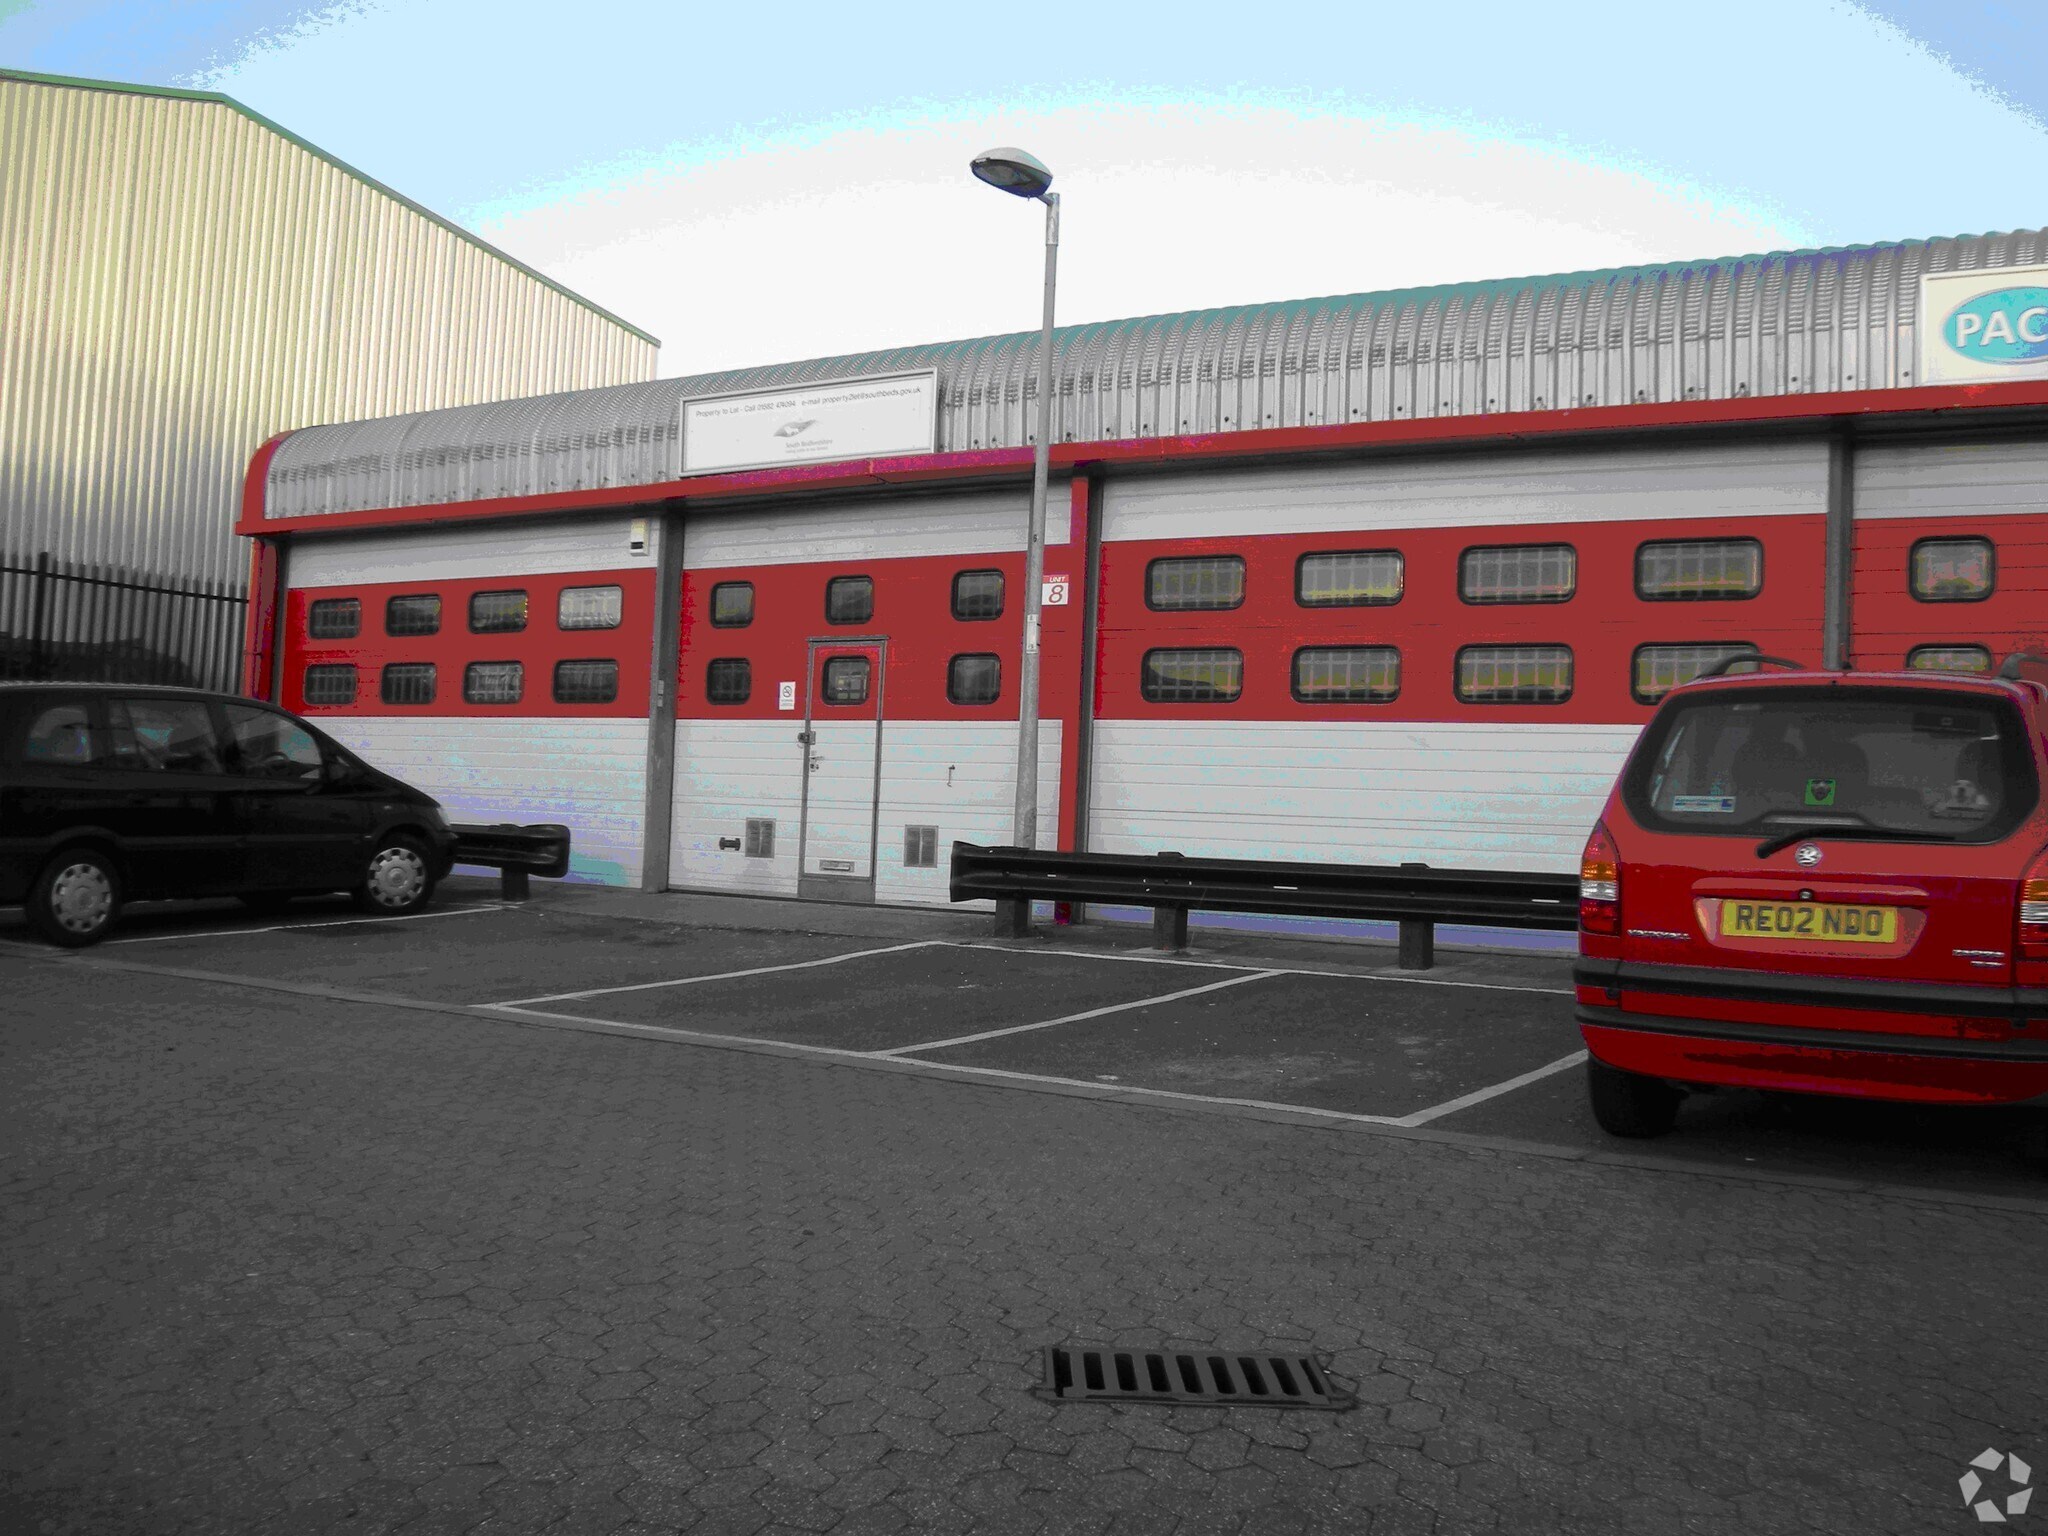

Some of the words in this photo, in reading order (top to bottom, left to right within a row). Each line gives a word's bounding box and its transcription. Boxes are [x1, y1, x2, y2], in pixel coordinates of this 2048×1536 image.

[696, 409, 721, 418] Property
[744, 404, 756, 412] Call
[801, 397, 821, 406] e-mail
[1048, 584, 1064, 604] 8
[1736, 904, 1814, 933] RE02
